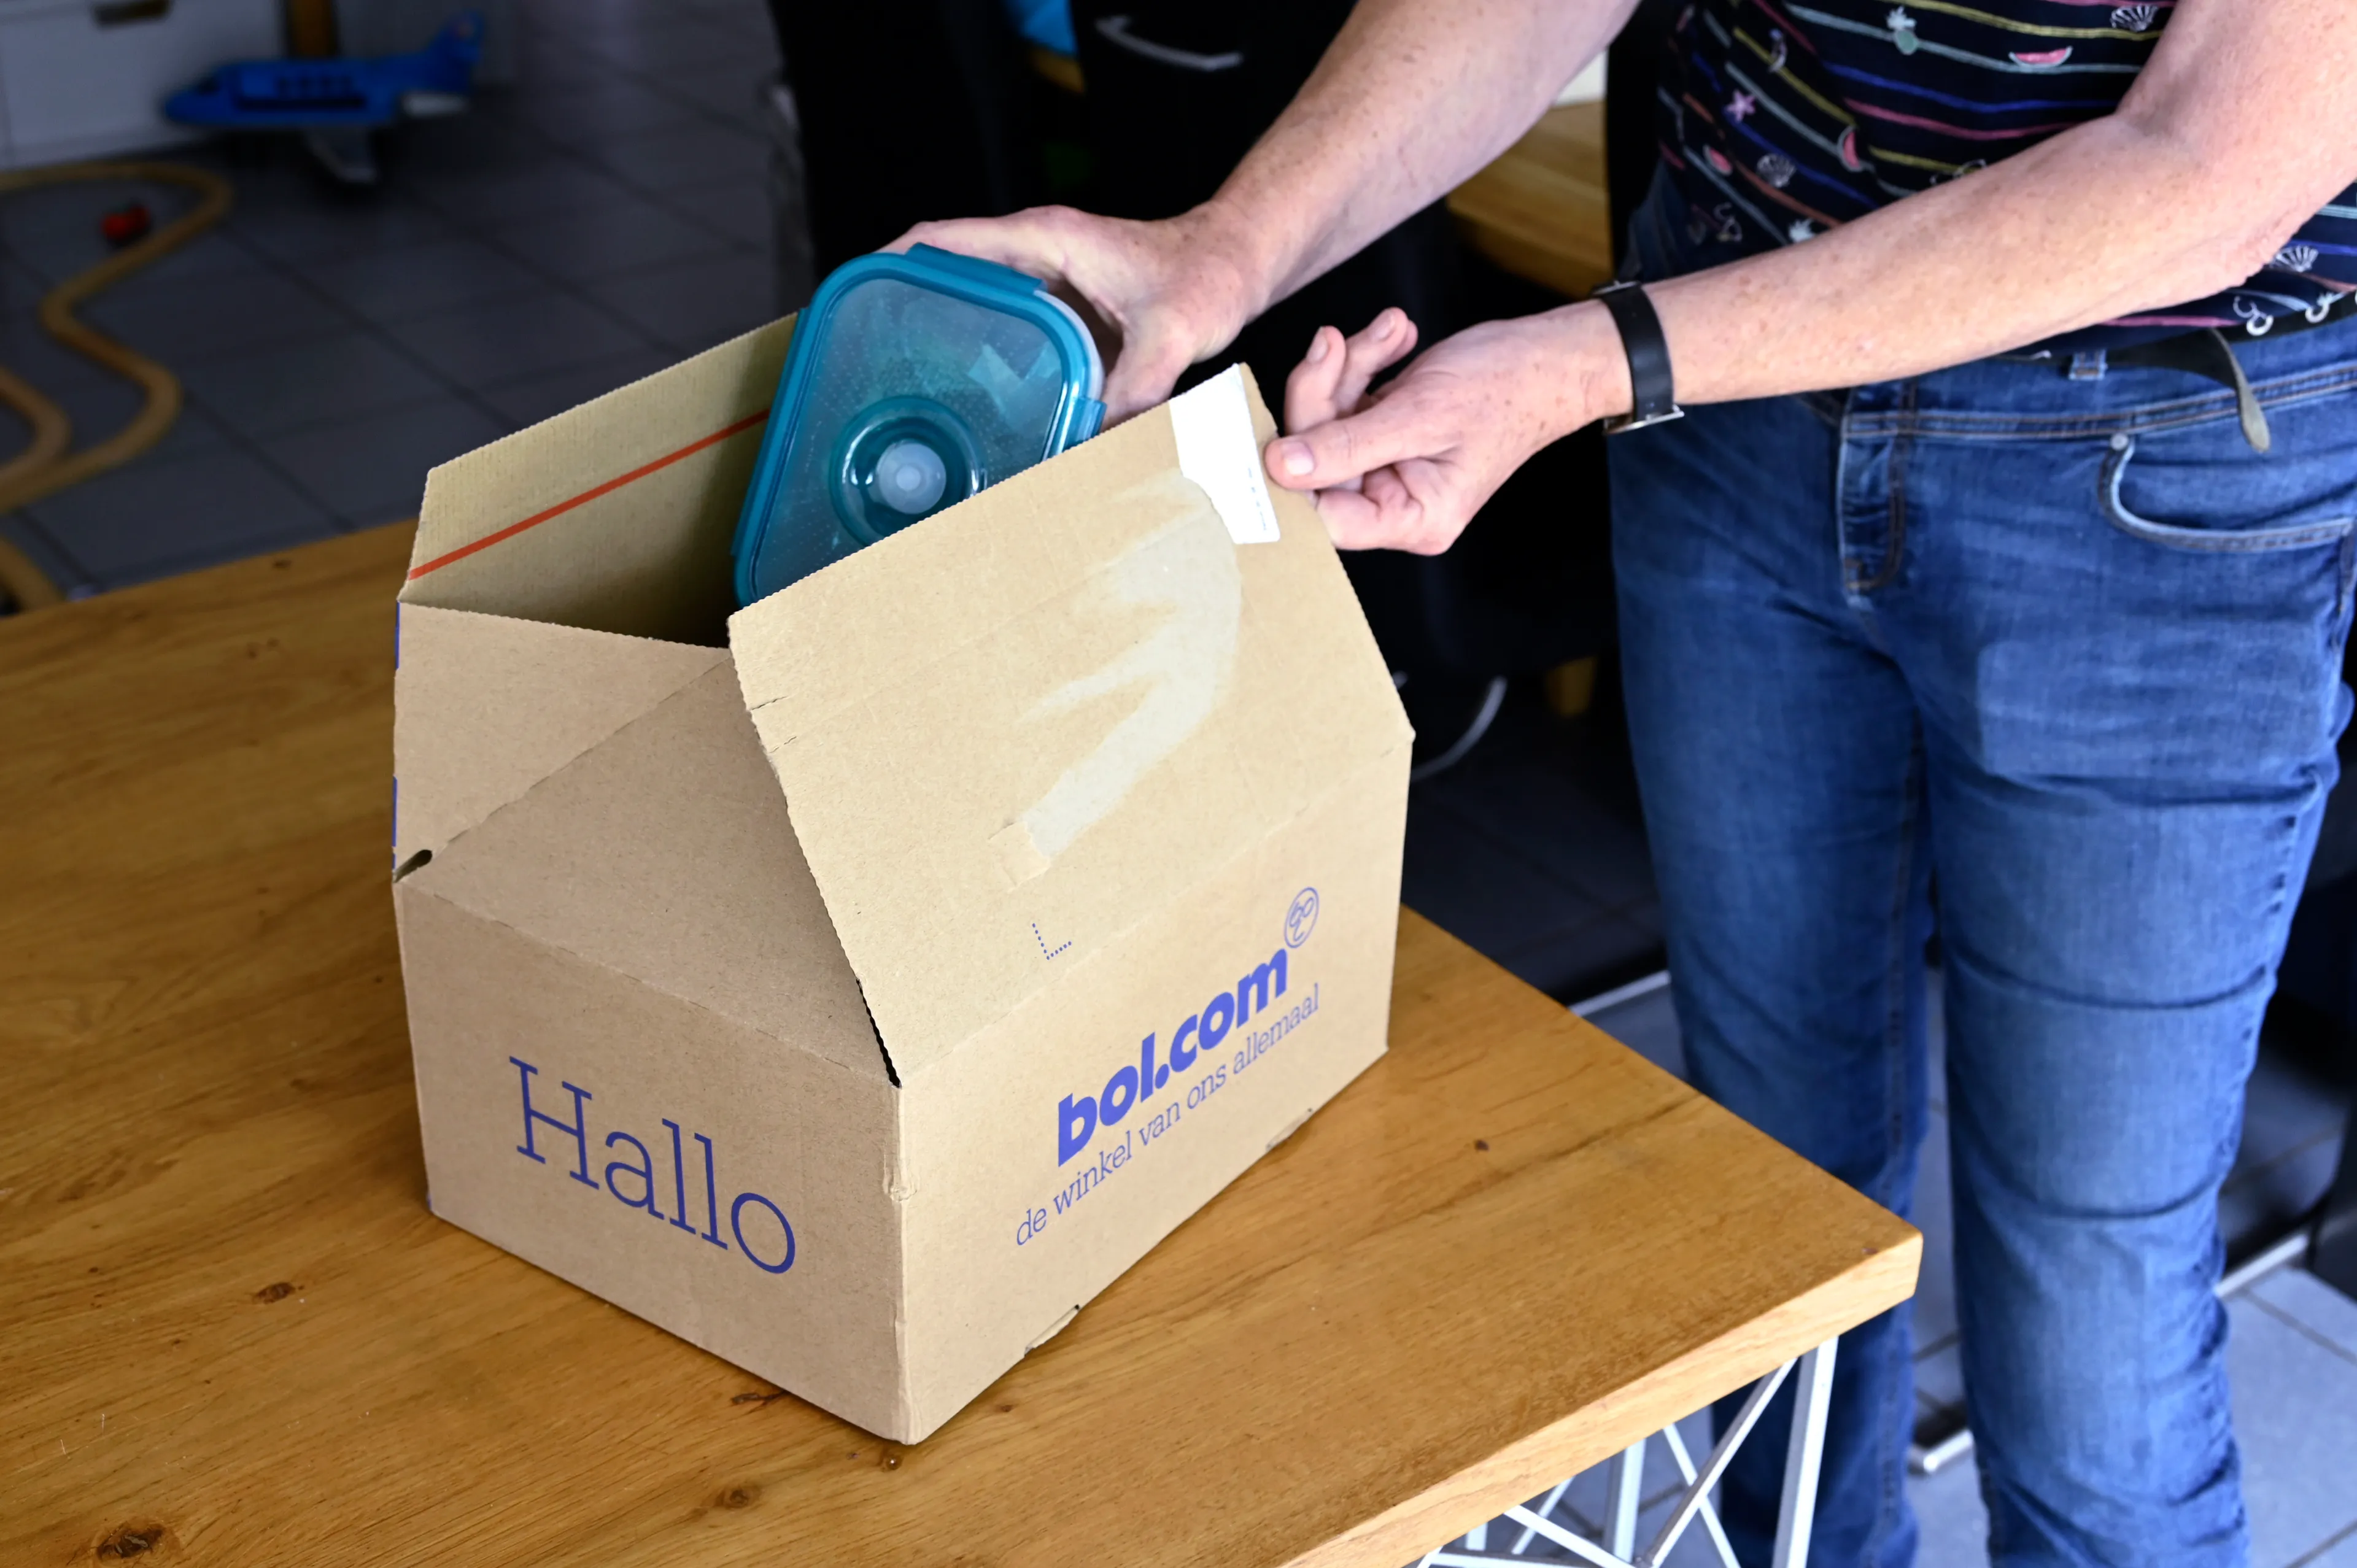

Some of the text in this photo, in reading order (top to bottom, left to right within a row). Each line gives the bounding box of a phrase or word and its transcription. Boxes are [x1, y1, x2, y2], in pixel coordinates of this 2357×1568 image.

[510, 1057, 796, 1274] Hallo
[1016, 982, 1318, 1246] de winkel van ons allemaal
[1058, 948, 1287, 1167] bol.com
